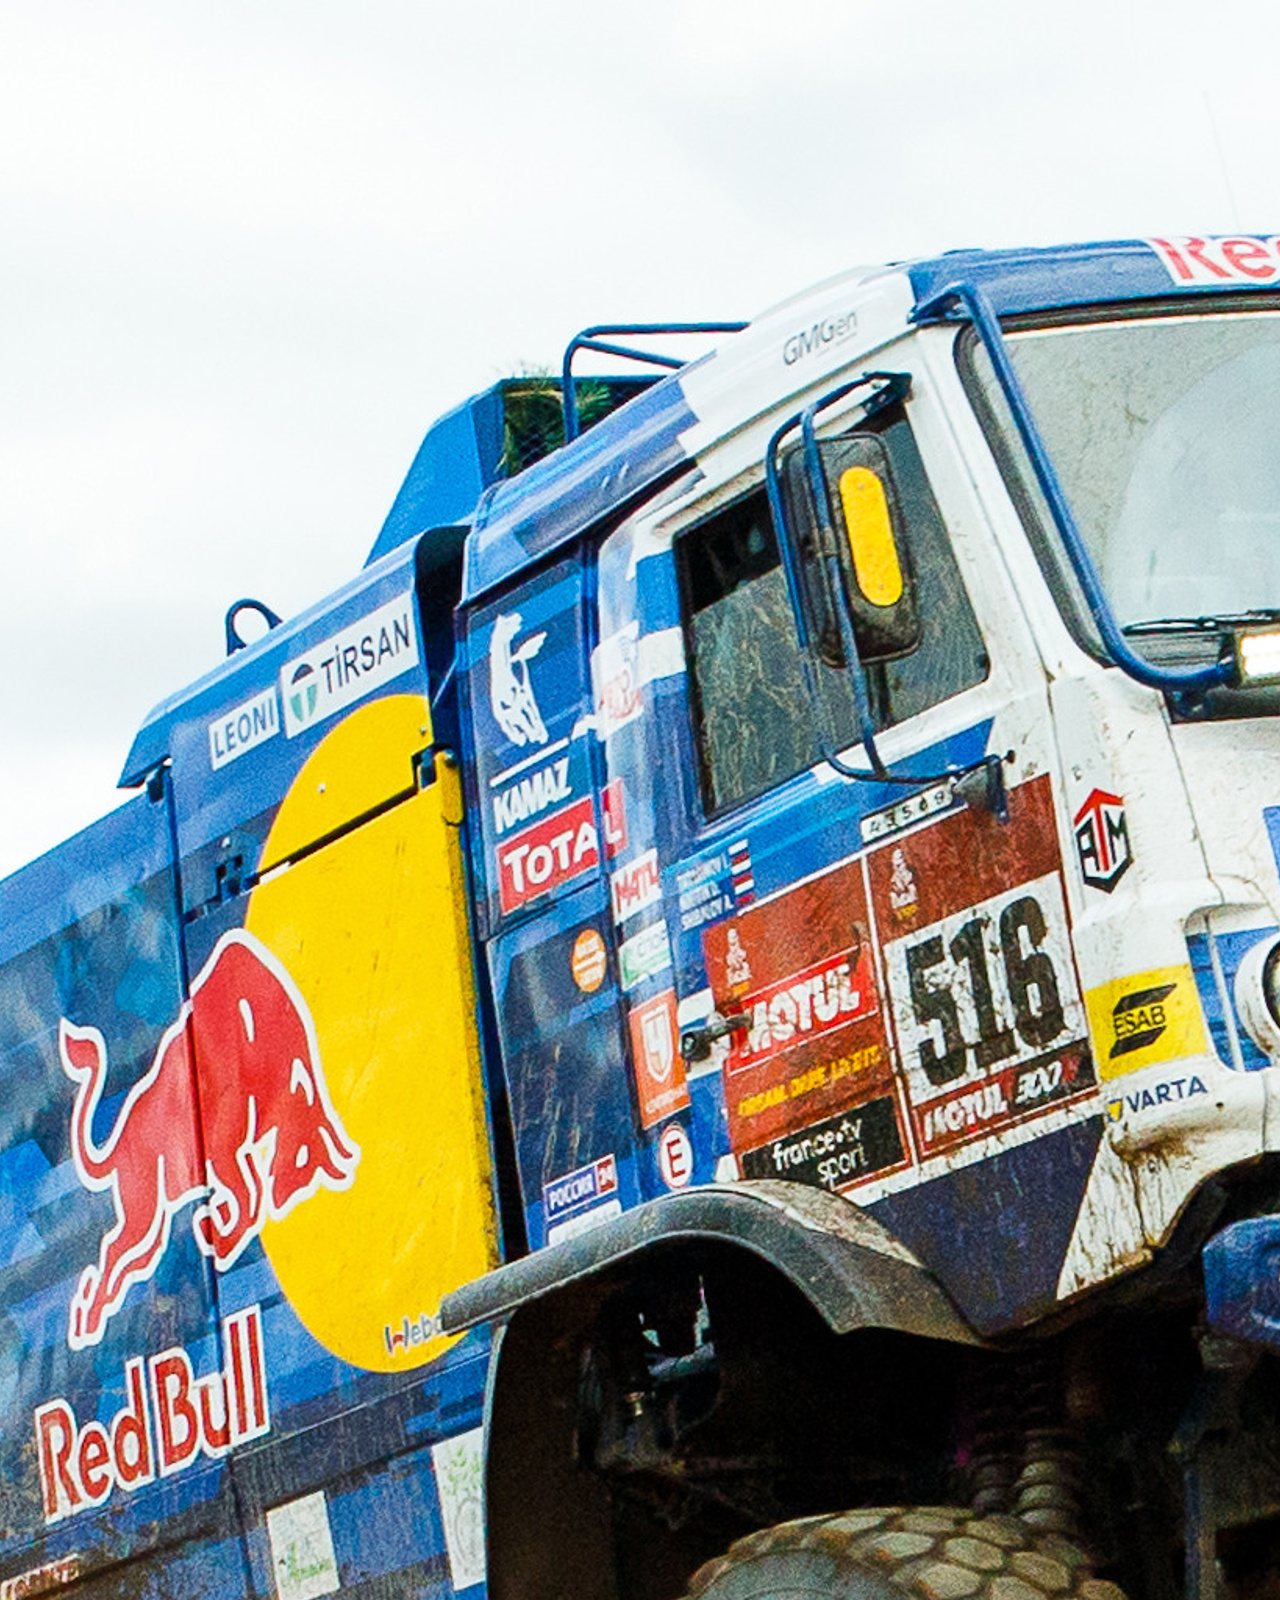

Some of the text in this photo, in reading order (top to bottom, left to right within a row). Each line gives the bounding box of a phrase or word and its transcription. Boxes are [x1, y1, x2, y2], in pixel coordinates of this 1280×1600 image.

[193, 697, 276, 759] LEONI
[493, 757, 572, 834] KAMAZ
[502, 813, 622, 894] TOTAL
[739, 963, 860, 1059] MOTUL
[905, 895, 1068, 1086] 516
[1113, 1004, 1167, 1038] ESAB
[1126, 1075, 1208, 1114] VARTA
[666, 1138, 686, 1178] E
[817, 1143, 869, 1192] sport
